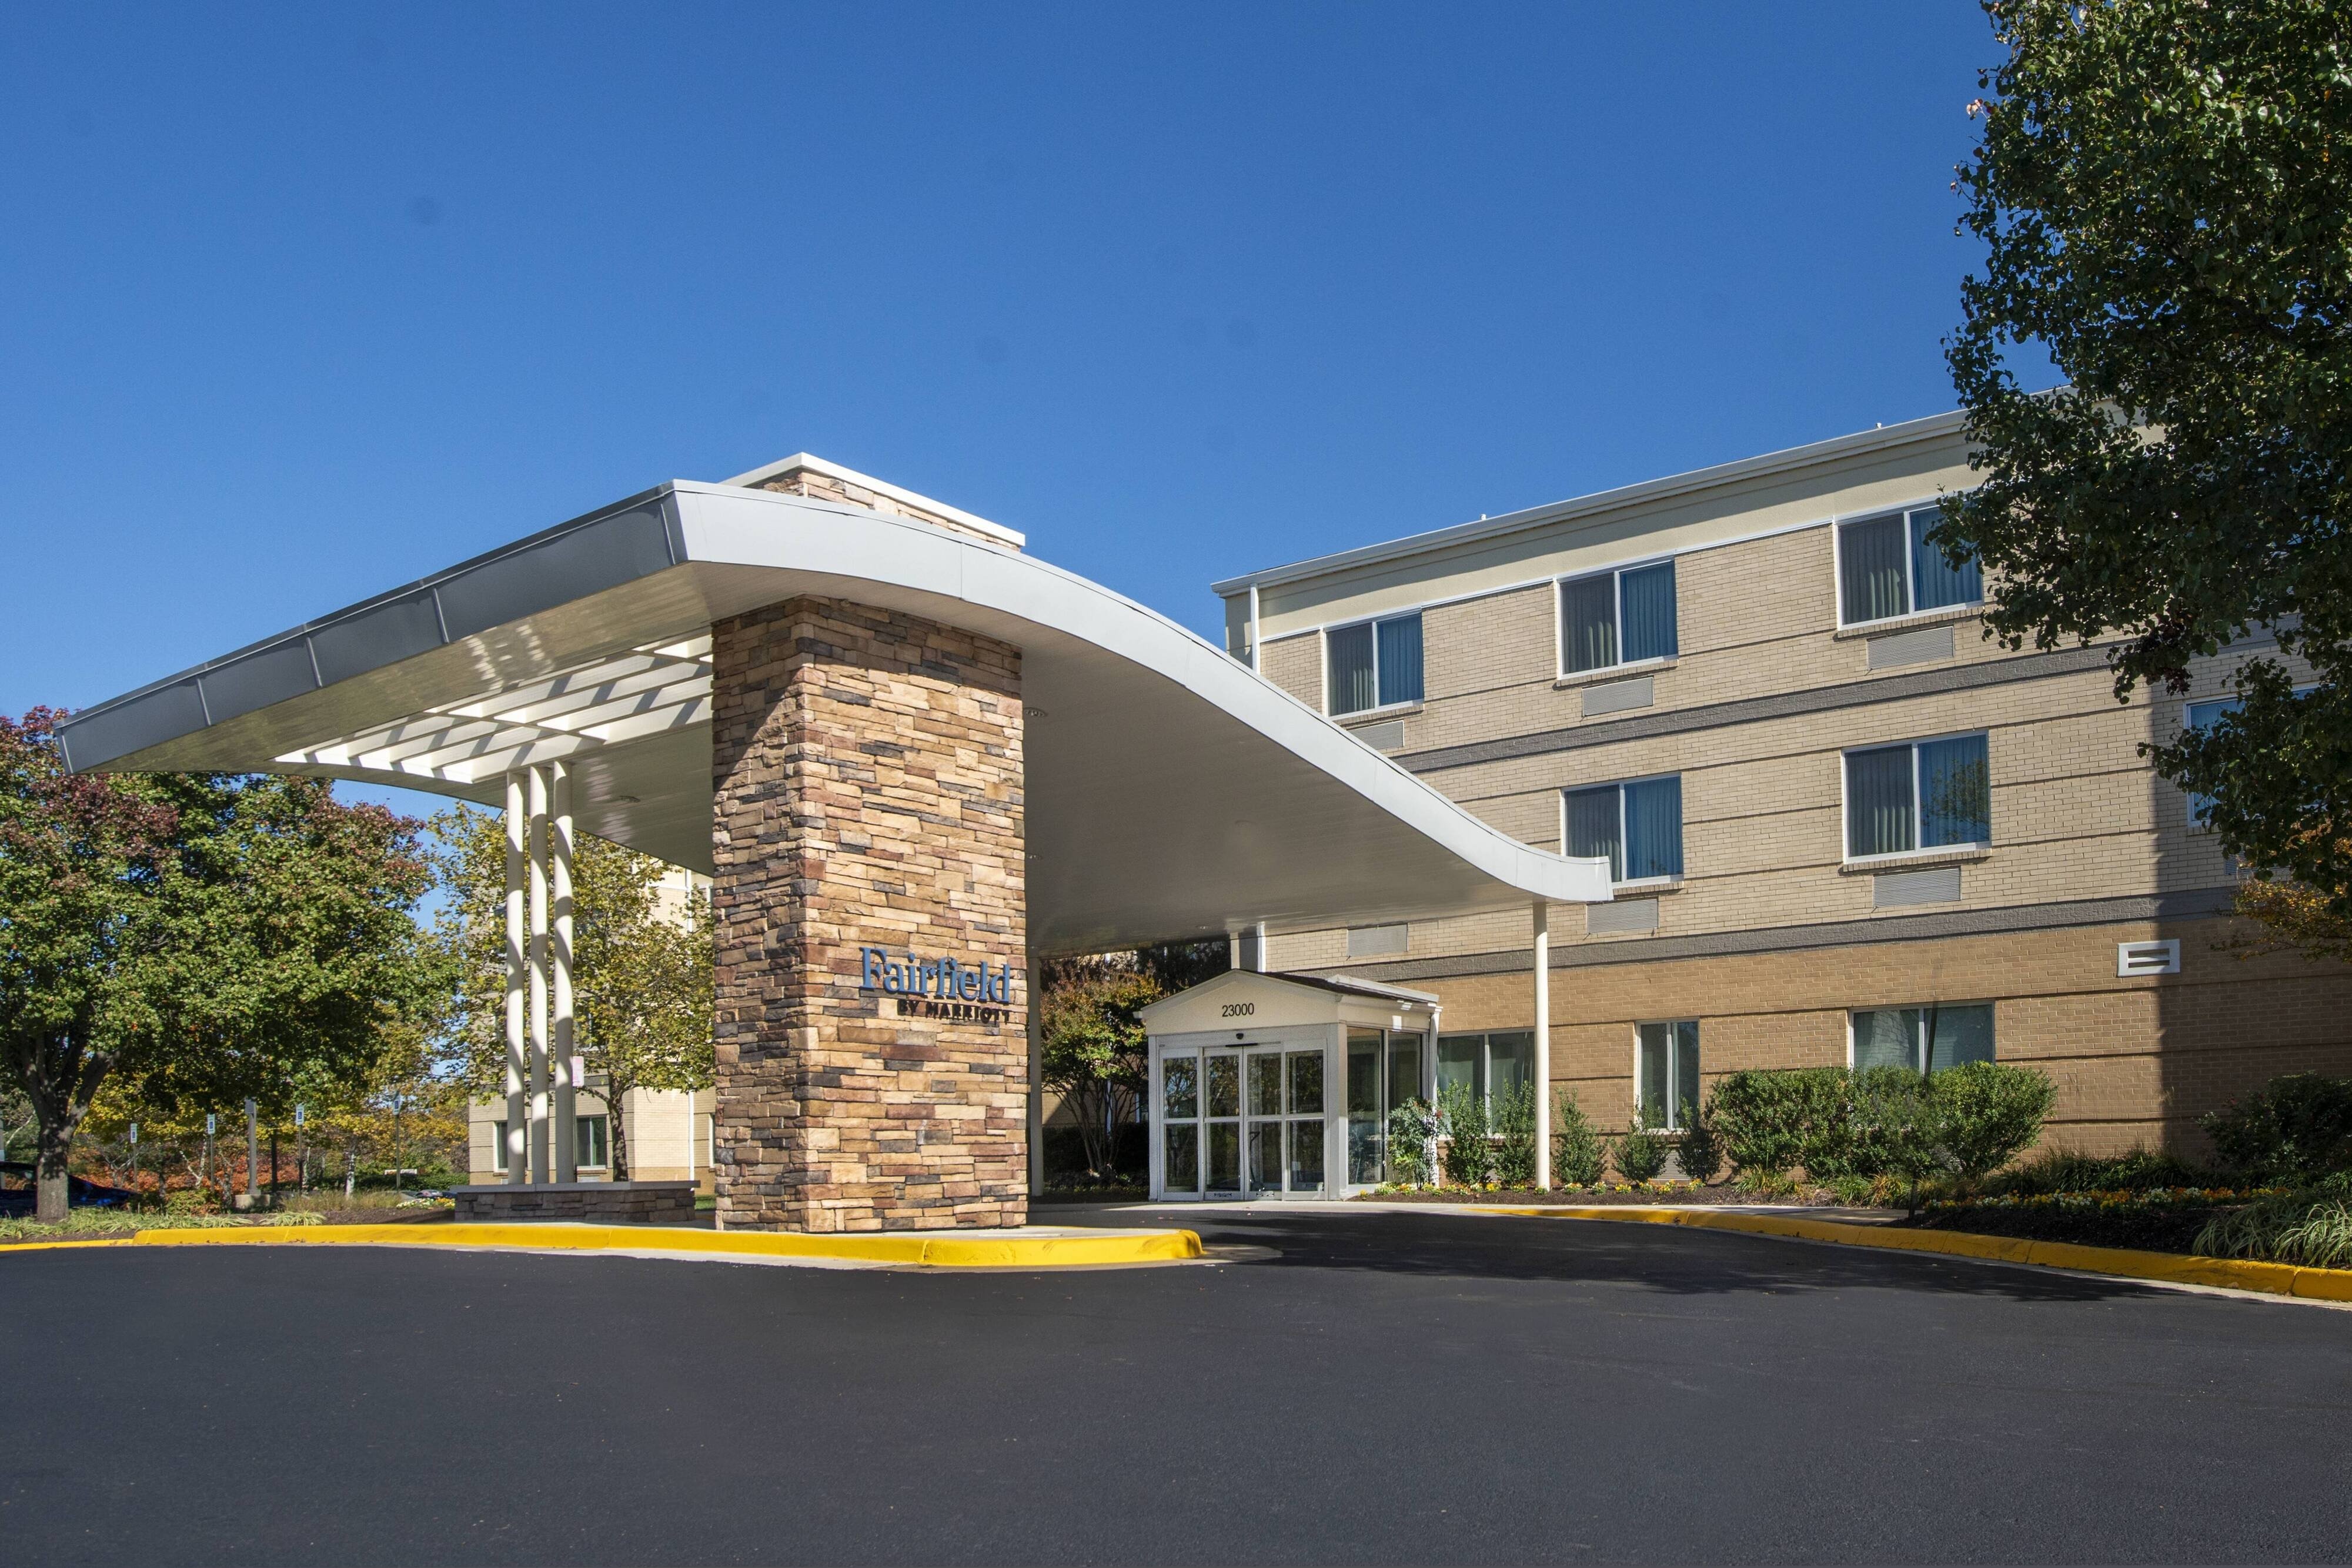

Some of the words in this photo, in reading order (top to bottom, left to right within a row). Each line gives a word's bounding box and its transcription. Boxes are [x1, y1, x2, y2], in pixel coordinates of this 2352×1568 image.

[859, 947, 1011, 1004] Fairfield
[898, 999, 920, 1017] BY
[925, 1002, 1010, 1024] MARRIOTT
[1222, 1002, 1254, 1017] 23000
